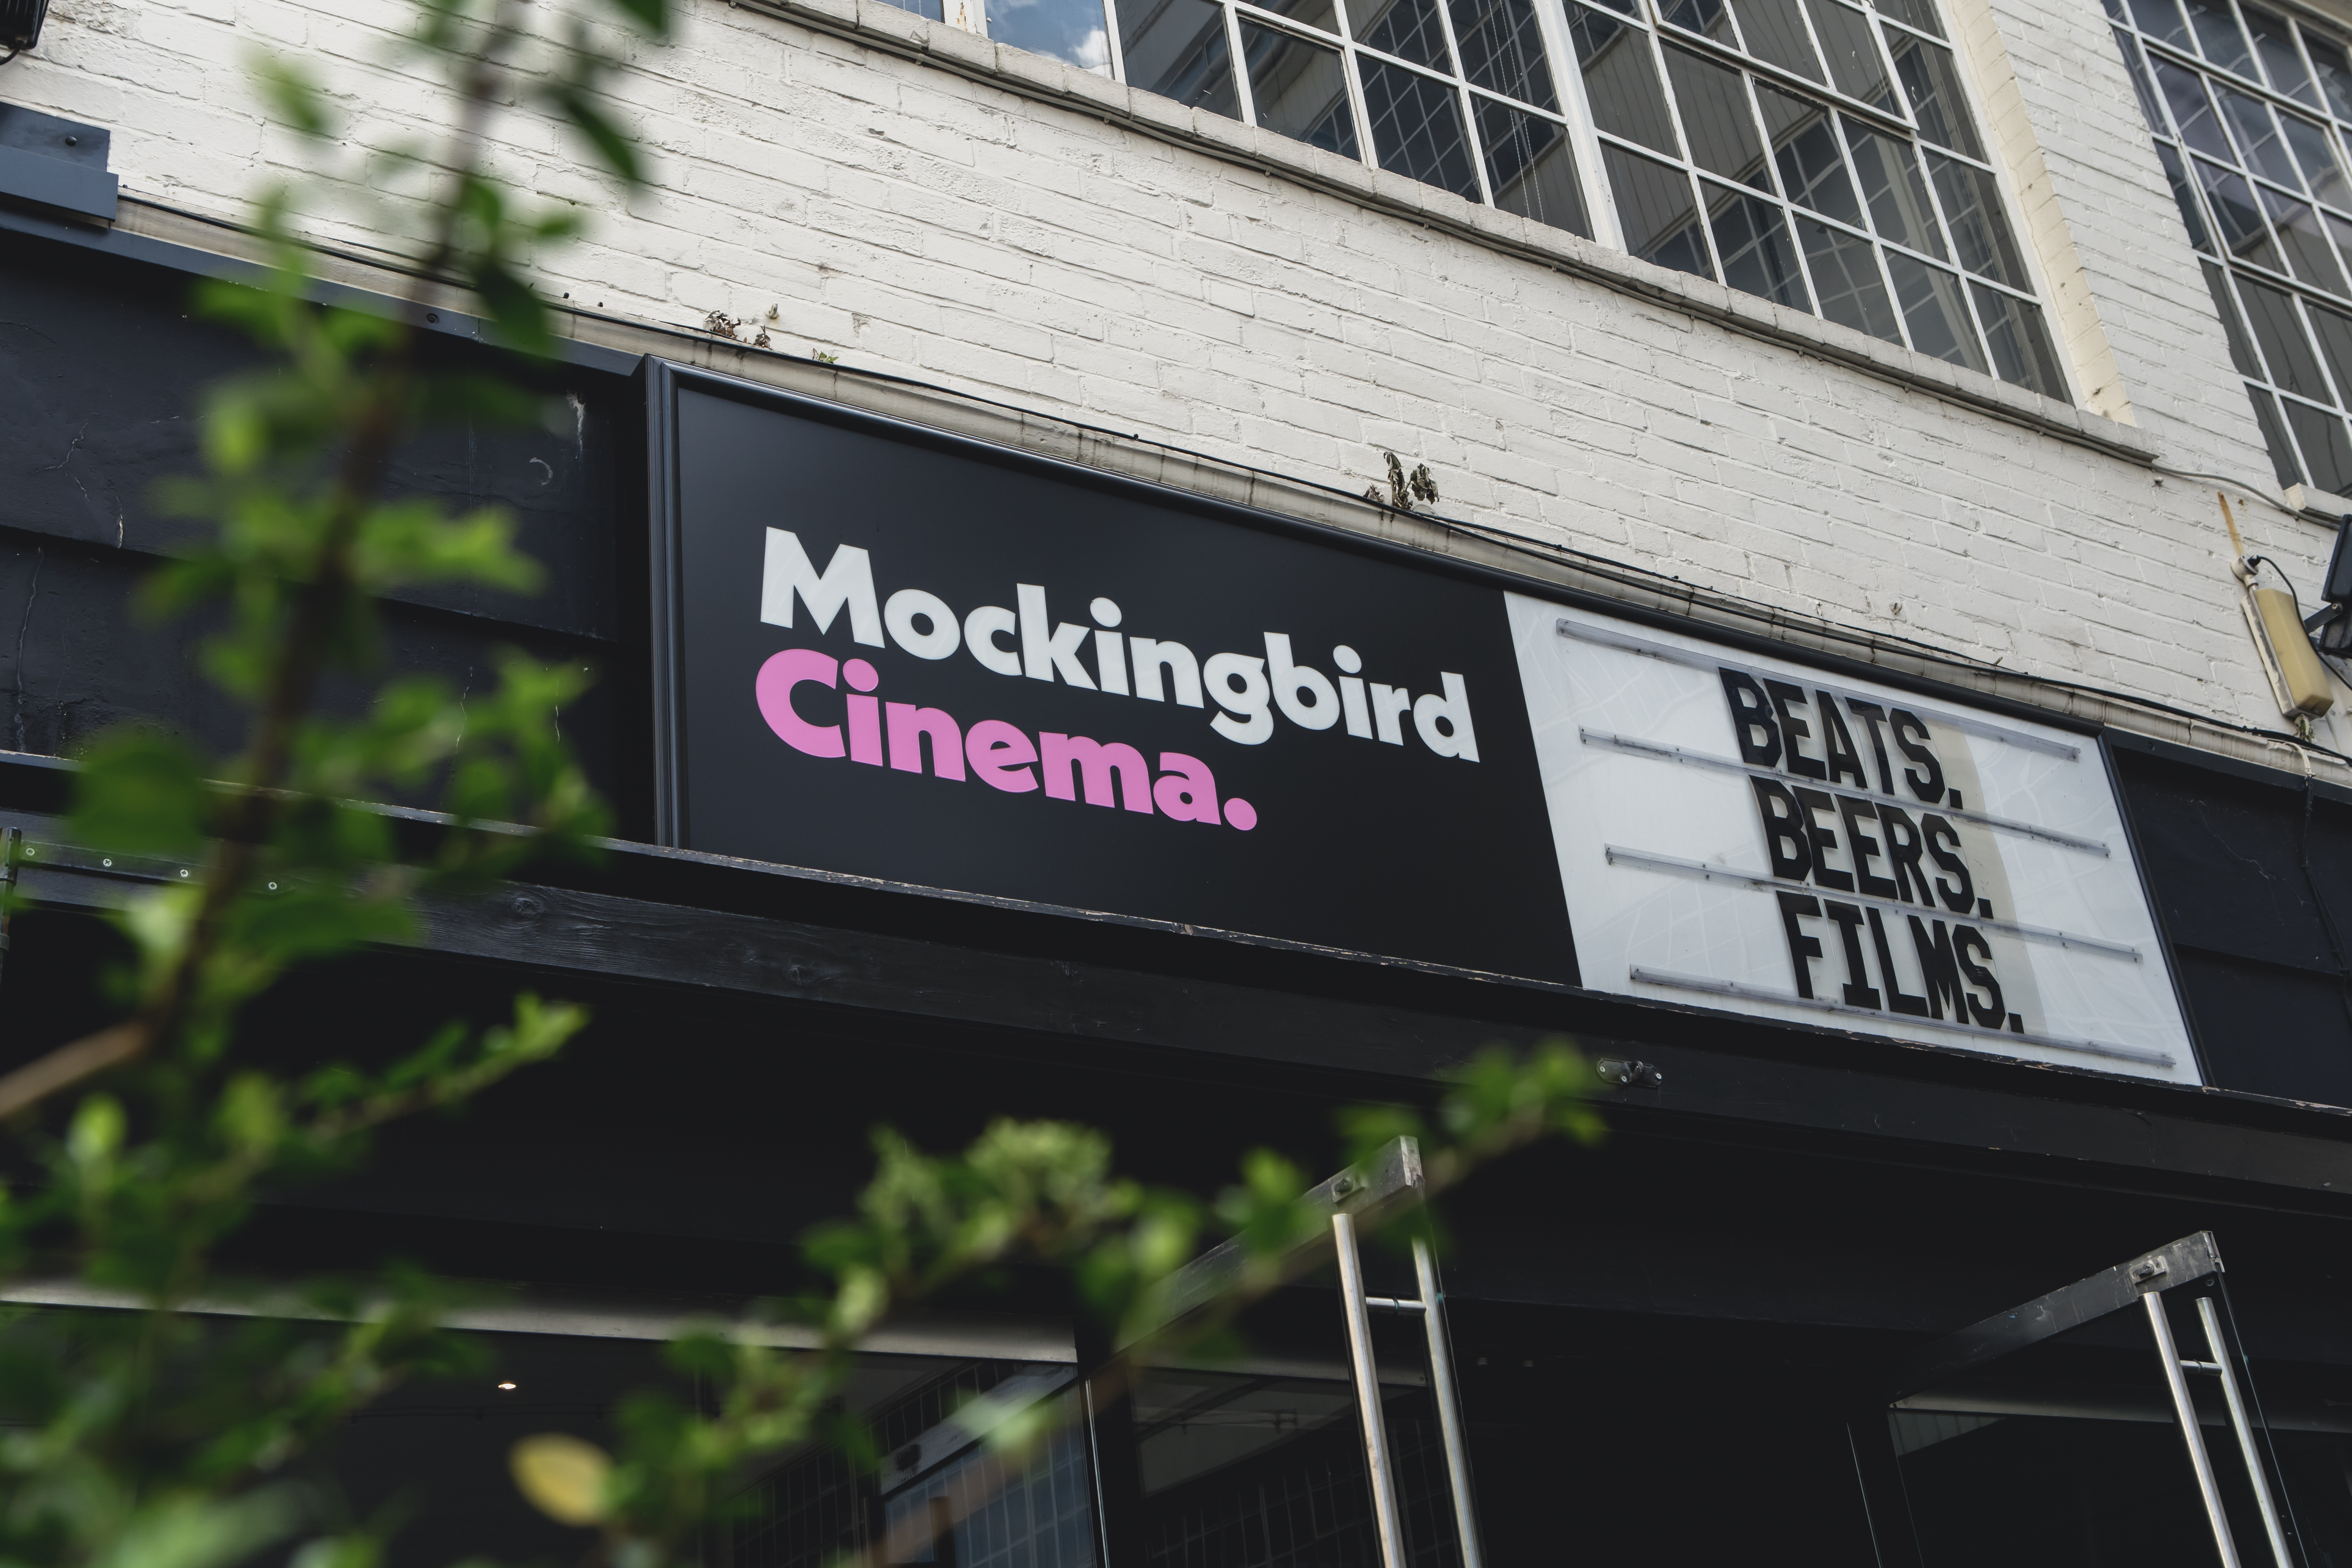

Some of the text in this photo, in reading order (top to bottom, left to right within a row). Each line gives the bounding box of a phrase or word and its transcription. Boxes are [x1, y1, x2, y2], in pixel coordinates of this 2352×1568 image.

[760, 527, 1480, 763] Mockingbird
[755, 649, 1258, 831] Cinema.
[1718, 666, 1964, 810] BEATS.
[1749, 775, 1994, 919] BEERS.
[1776, 890, 2025, 1034] FILMS.
